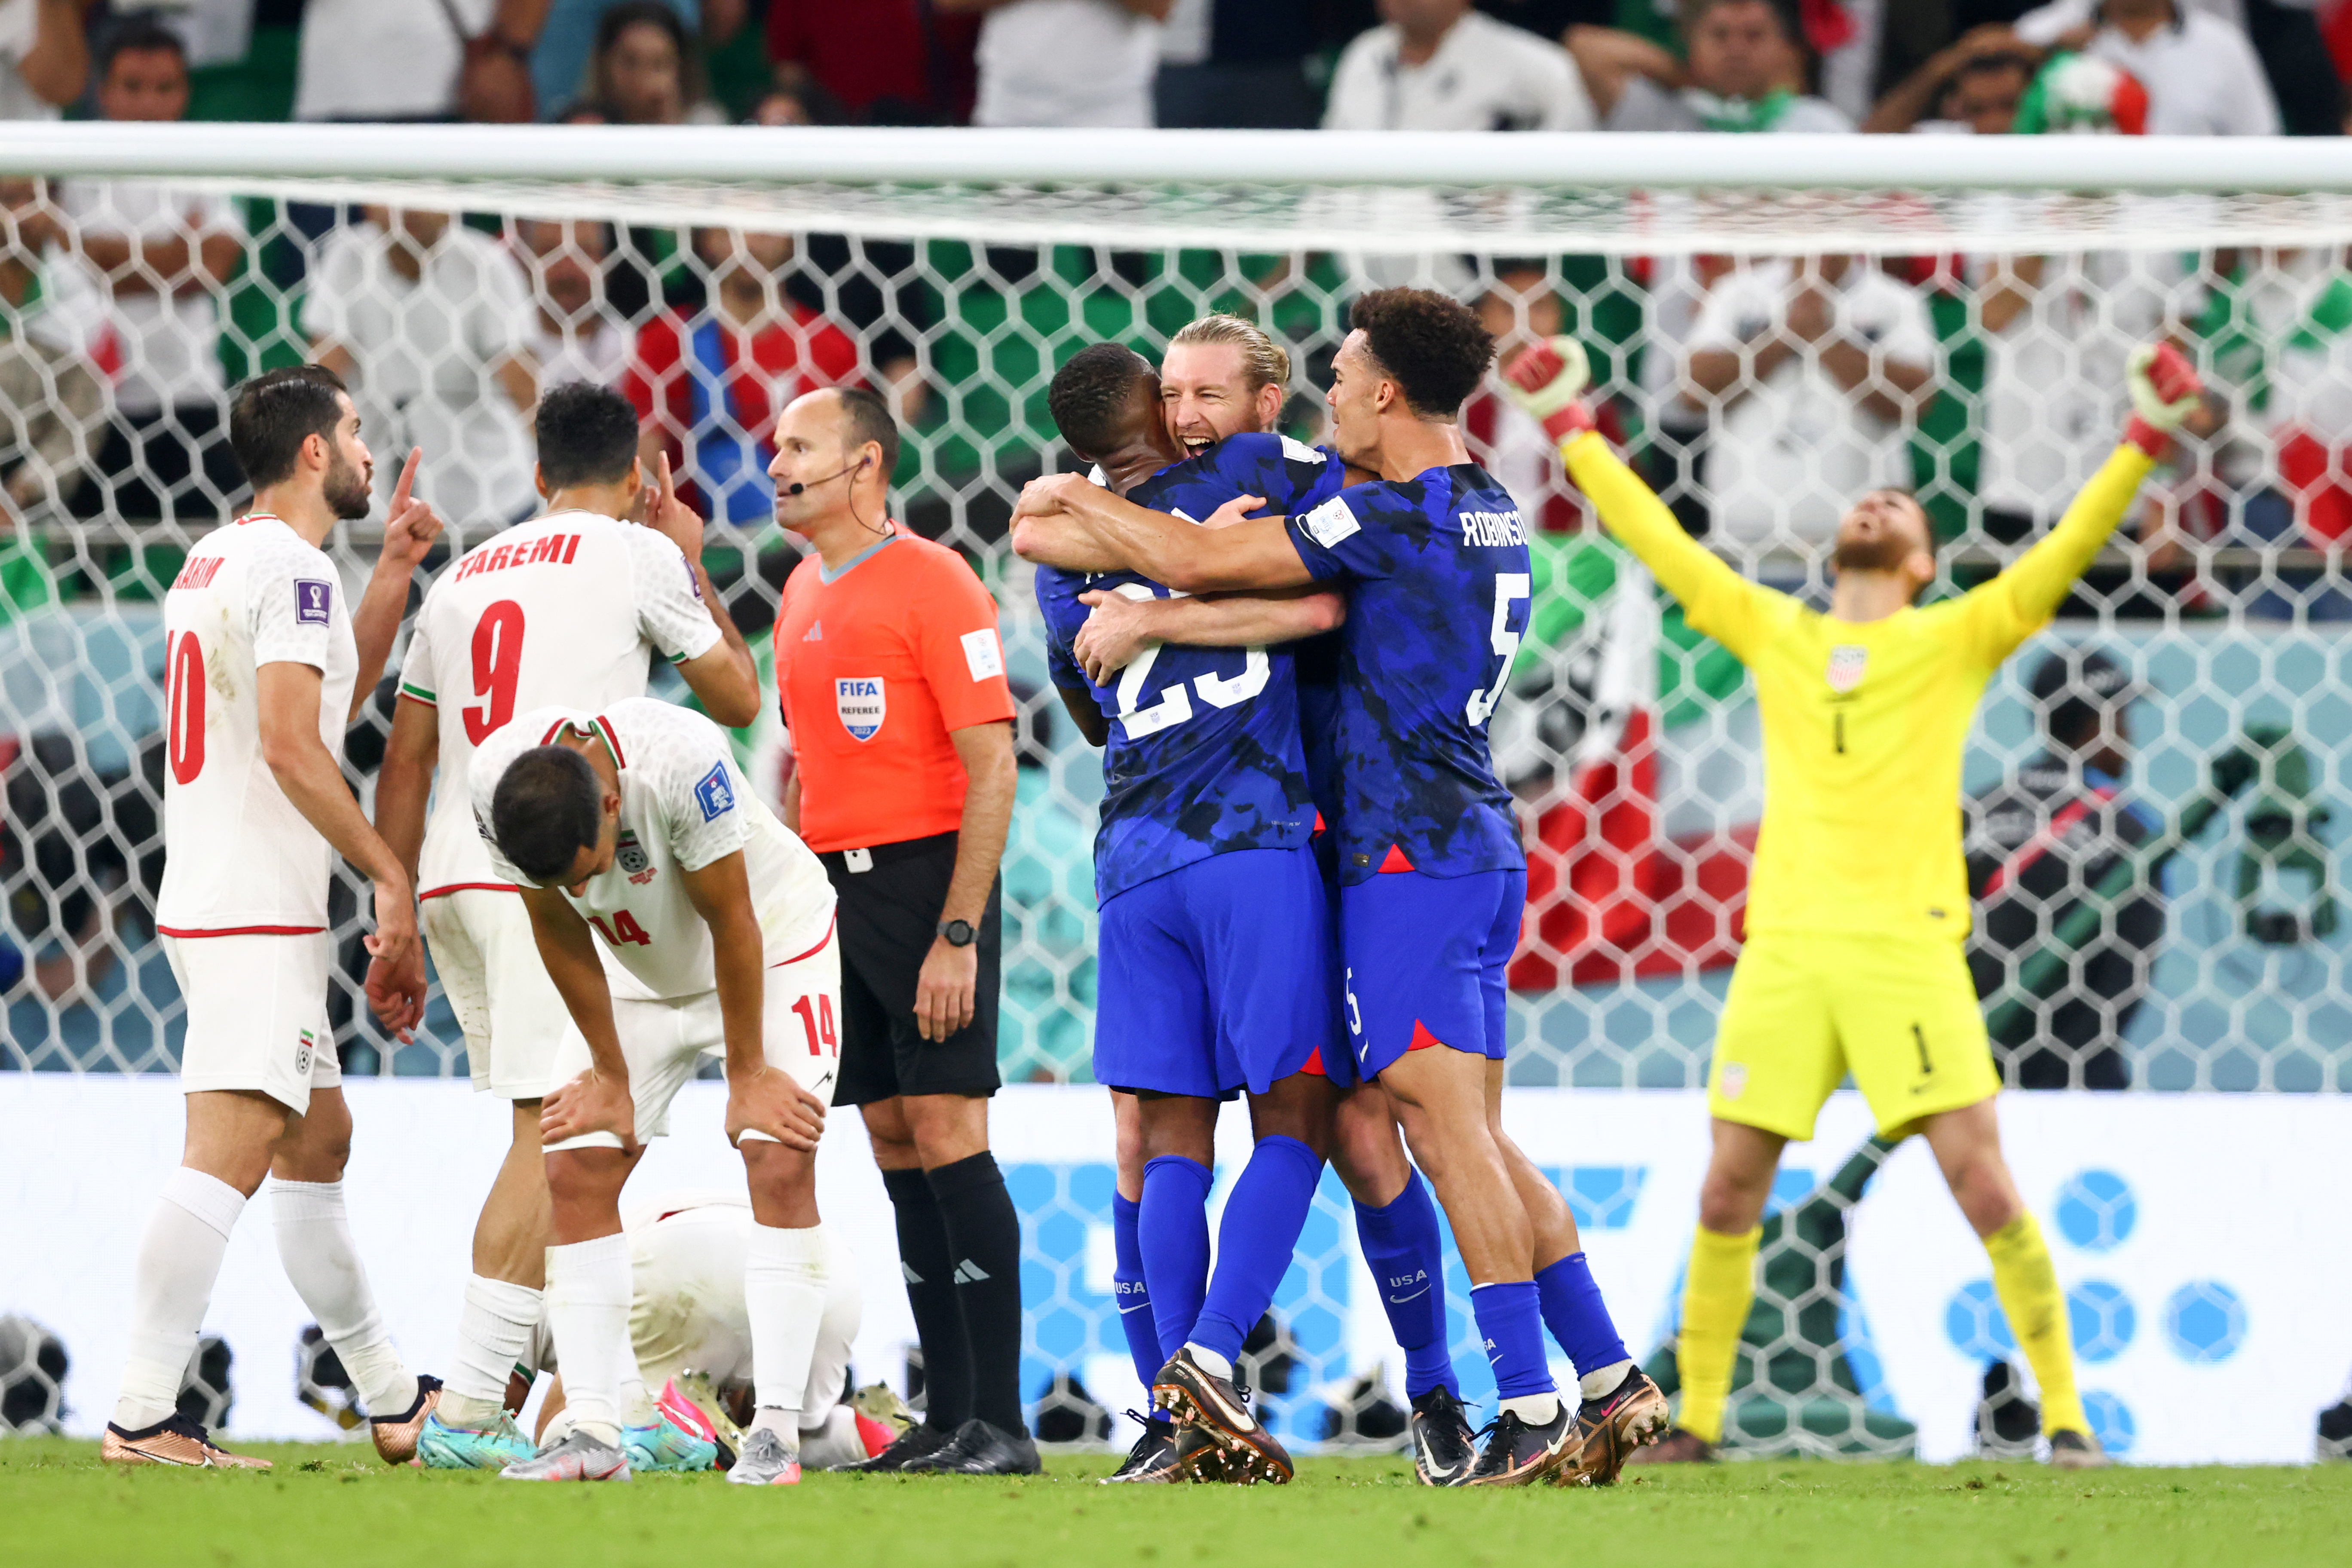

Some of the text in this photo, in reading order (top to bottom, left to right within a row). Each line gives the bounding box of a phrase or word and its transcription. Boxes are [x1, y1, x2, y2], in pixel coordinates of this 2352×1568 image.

[1320, 516, 1332, 531] UNITES
[454, 533, 581, 583] TAREMI
[1466, 573, 1530, 726] 5
[462, 599, 525, 747] 9
[840, 682, 878, 696] FIFA
[841, 705, 880, 714] REFEREE
[587, 909, 651, 946] 14
[1346, 967, 1362, 1036] 5
[791, 993, 837, 1058] 14
[1911, 1022, 1932, 1076] 1
[1115, 1281, 1145, 1294] USA
[1390, 1269, 1427, 1287] USA
